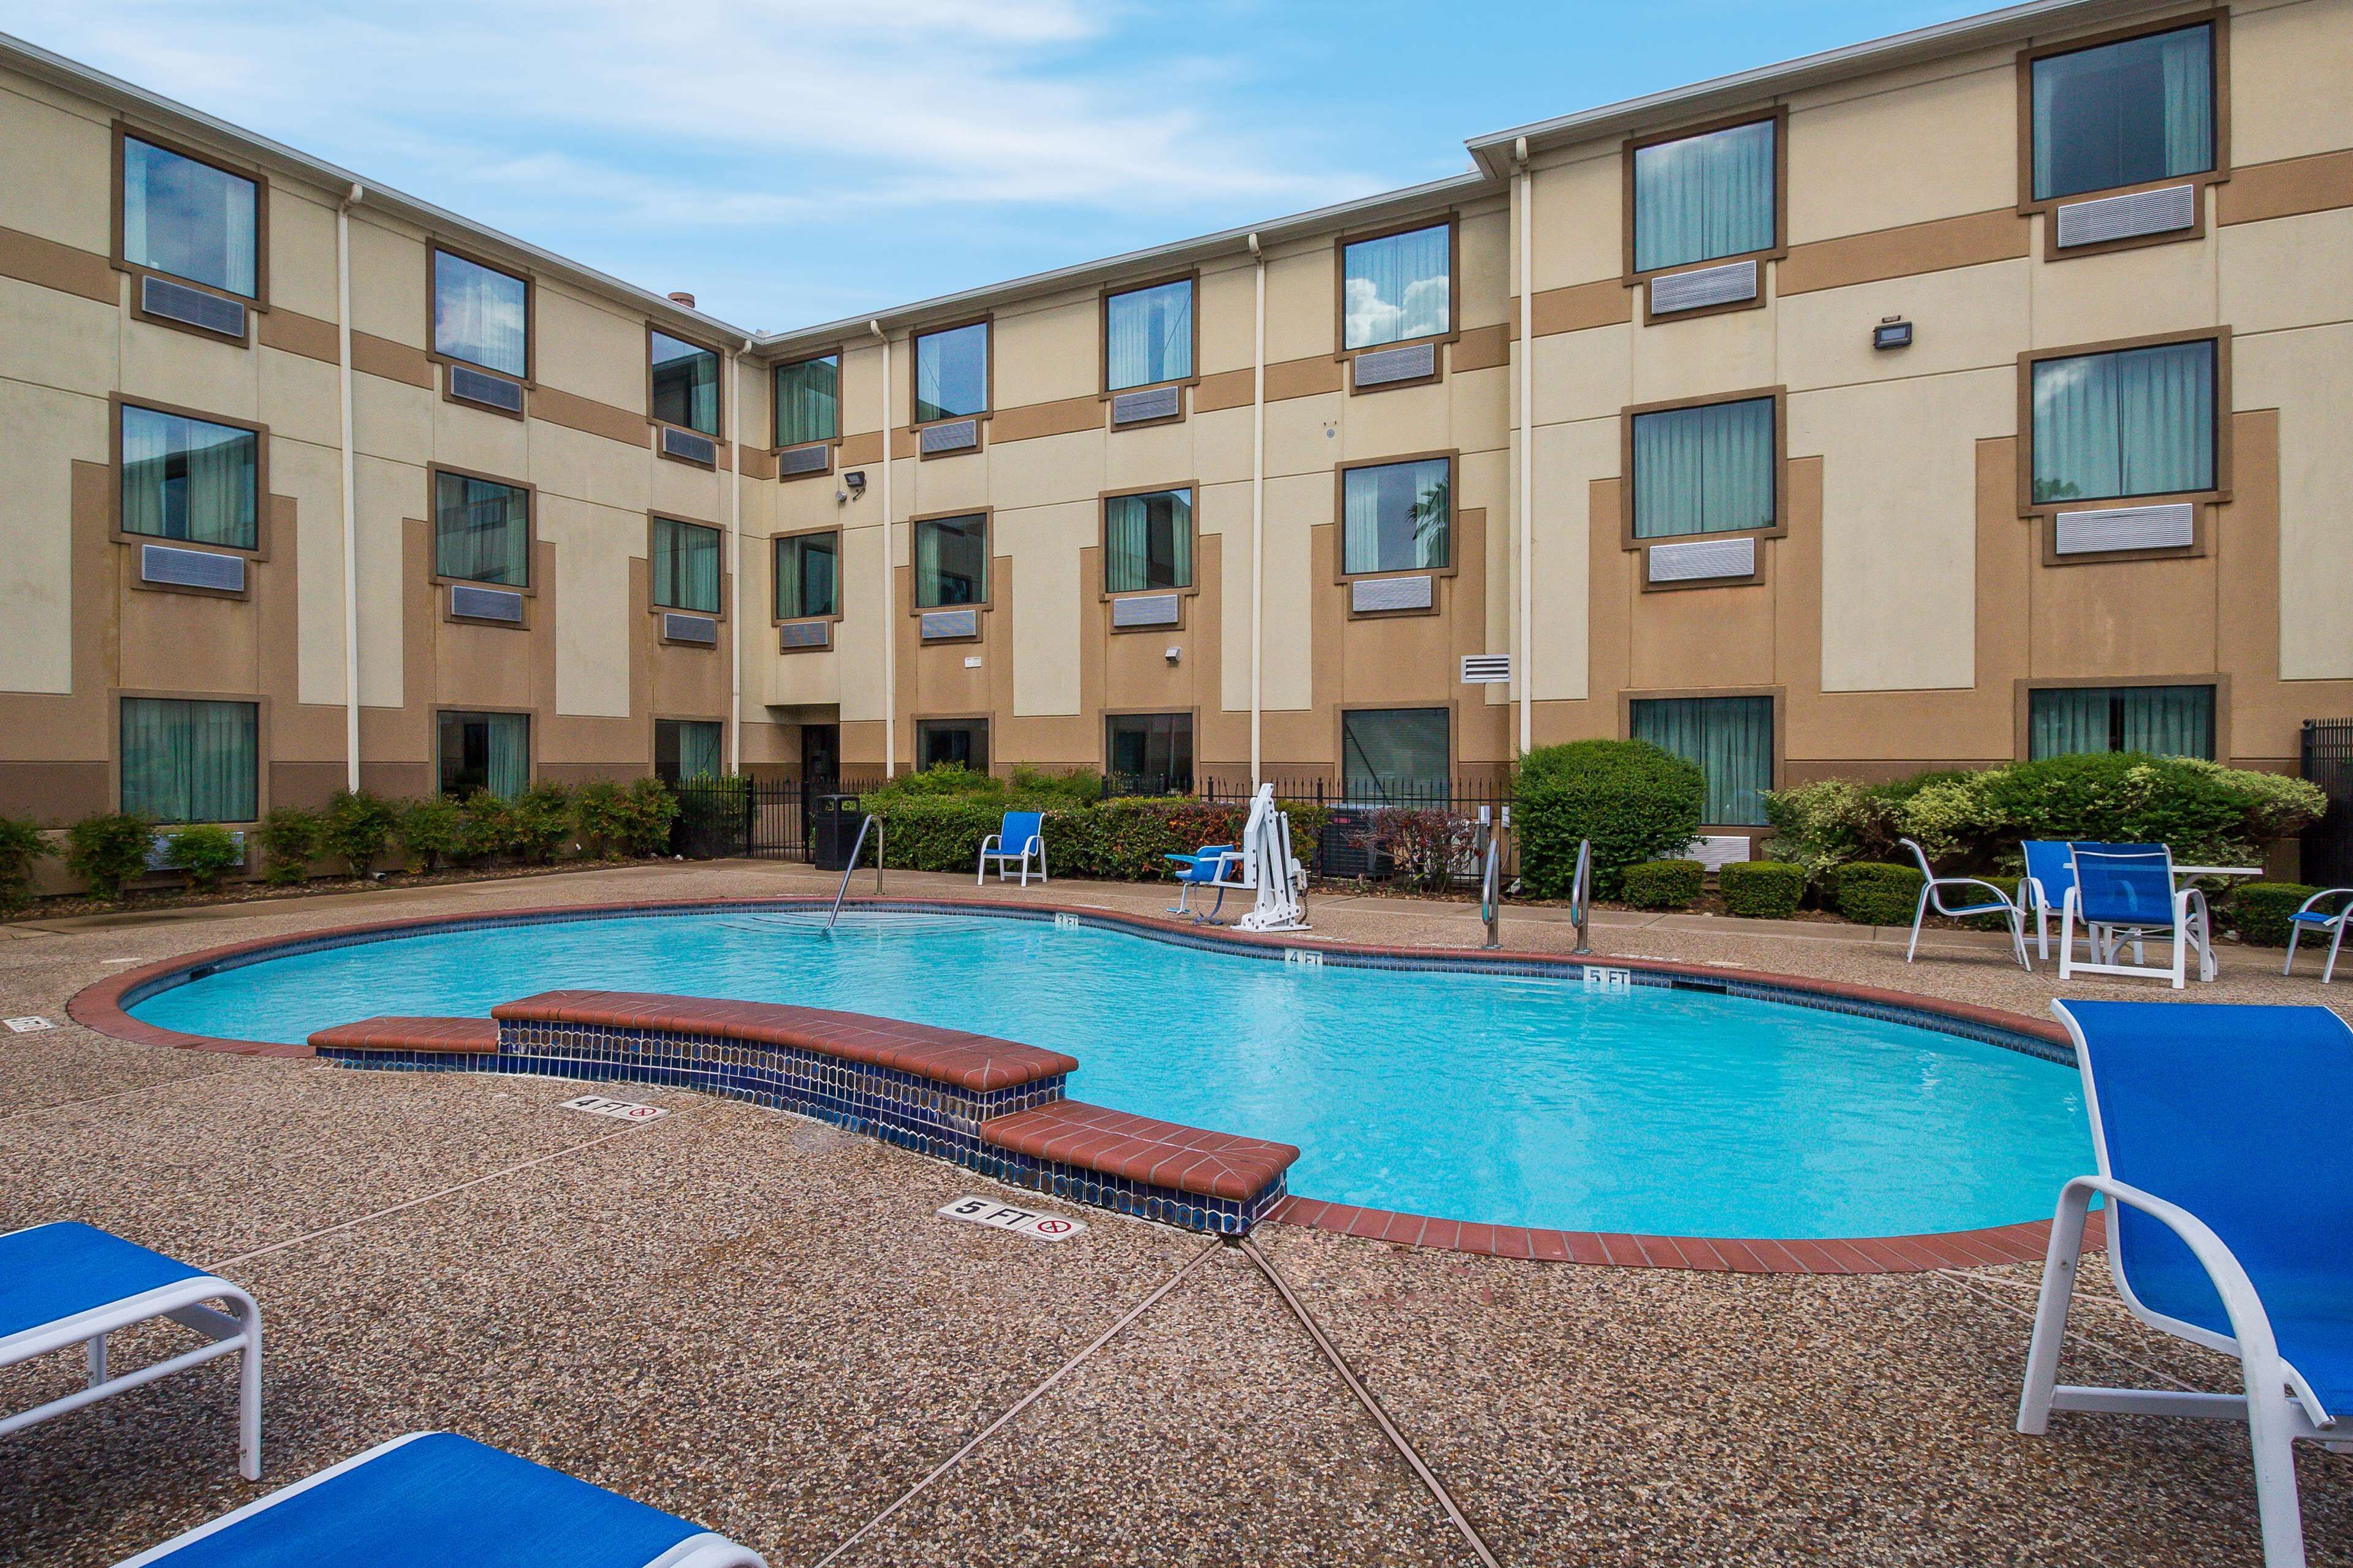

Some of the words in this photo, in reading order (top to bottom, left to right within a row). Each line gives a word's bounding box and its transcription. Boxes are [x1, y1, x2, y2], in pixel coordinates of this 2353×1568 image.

[1068, 915, 1078, 925] FT
[1290, 952, 1299, 962] 4
[1306, 953, 1320, 964] FT
[1590, 969, 1601, 982] 5
[1609, 971, 1628, 984] FT
[591, 1102, 634, 1113] FT
[955, 1200, 988, 1214] 5
[984, 1208, 1036, 1225] FT
